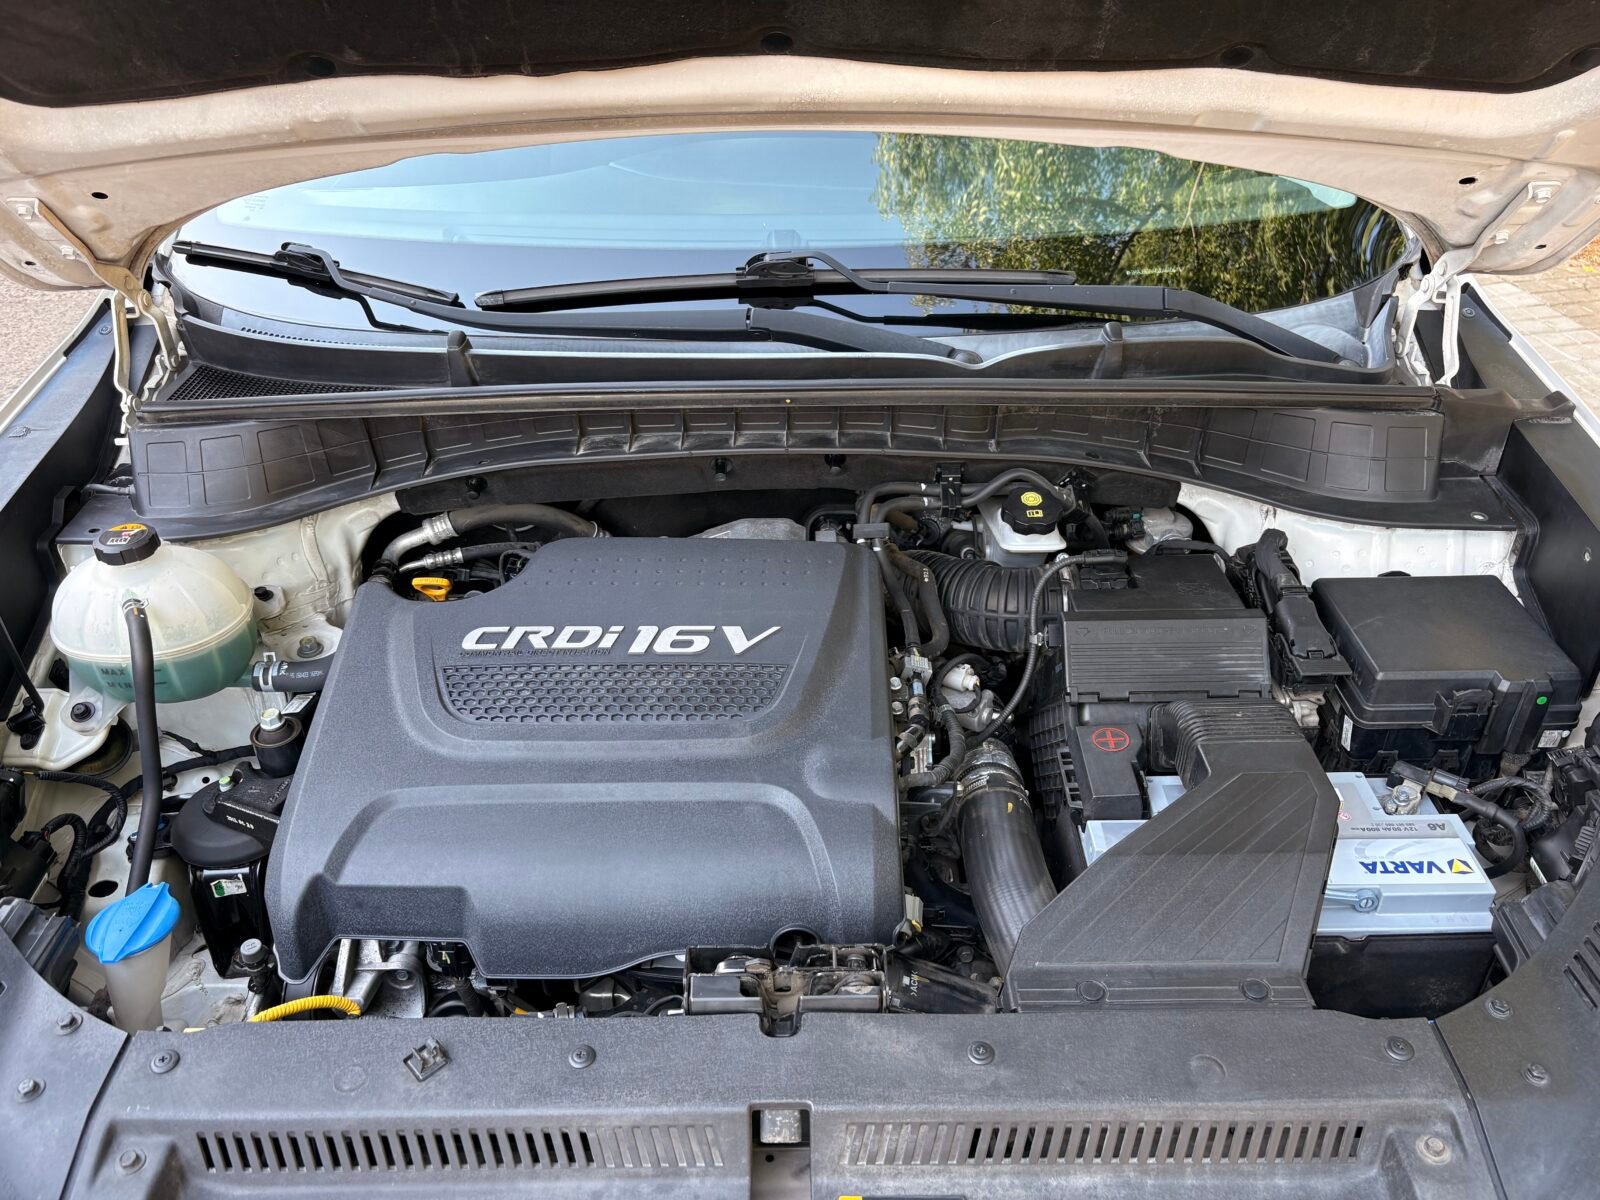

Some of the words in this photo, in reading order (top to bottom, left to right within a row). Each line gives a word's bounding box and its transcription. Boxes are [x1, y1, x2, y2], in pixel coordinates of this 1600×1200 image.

[461, 625, 626, 651] CRDi
[627, 625, 782, 656] 16V
[100, 668, 126, 676] MAX
[106, 681, 133, 689] MIN
[1359, 860, 1446, 874] VARTA
